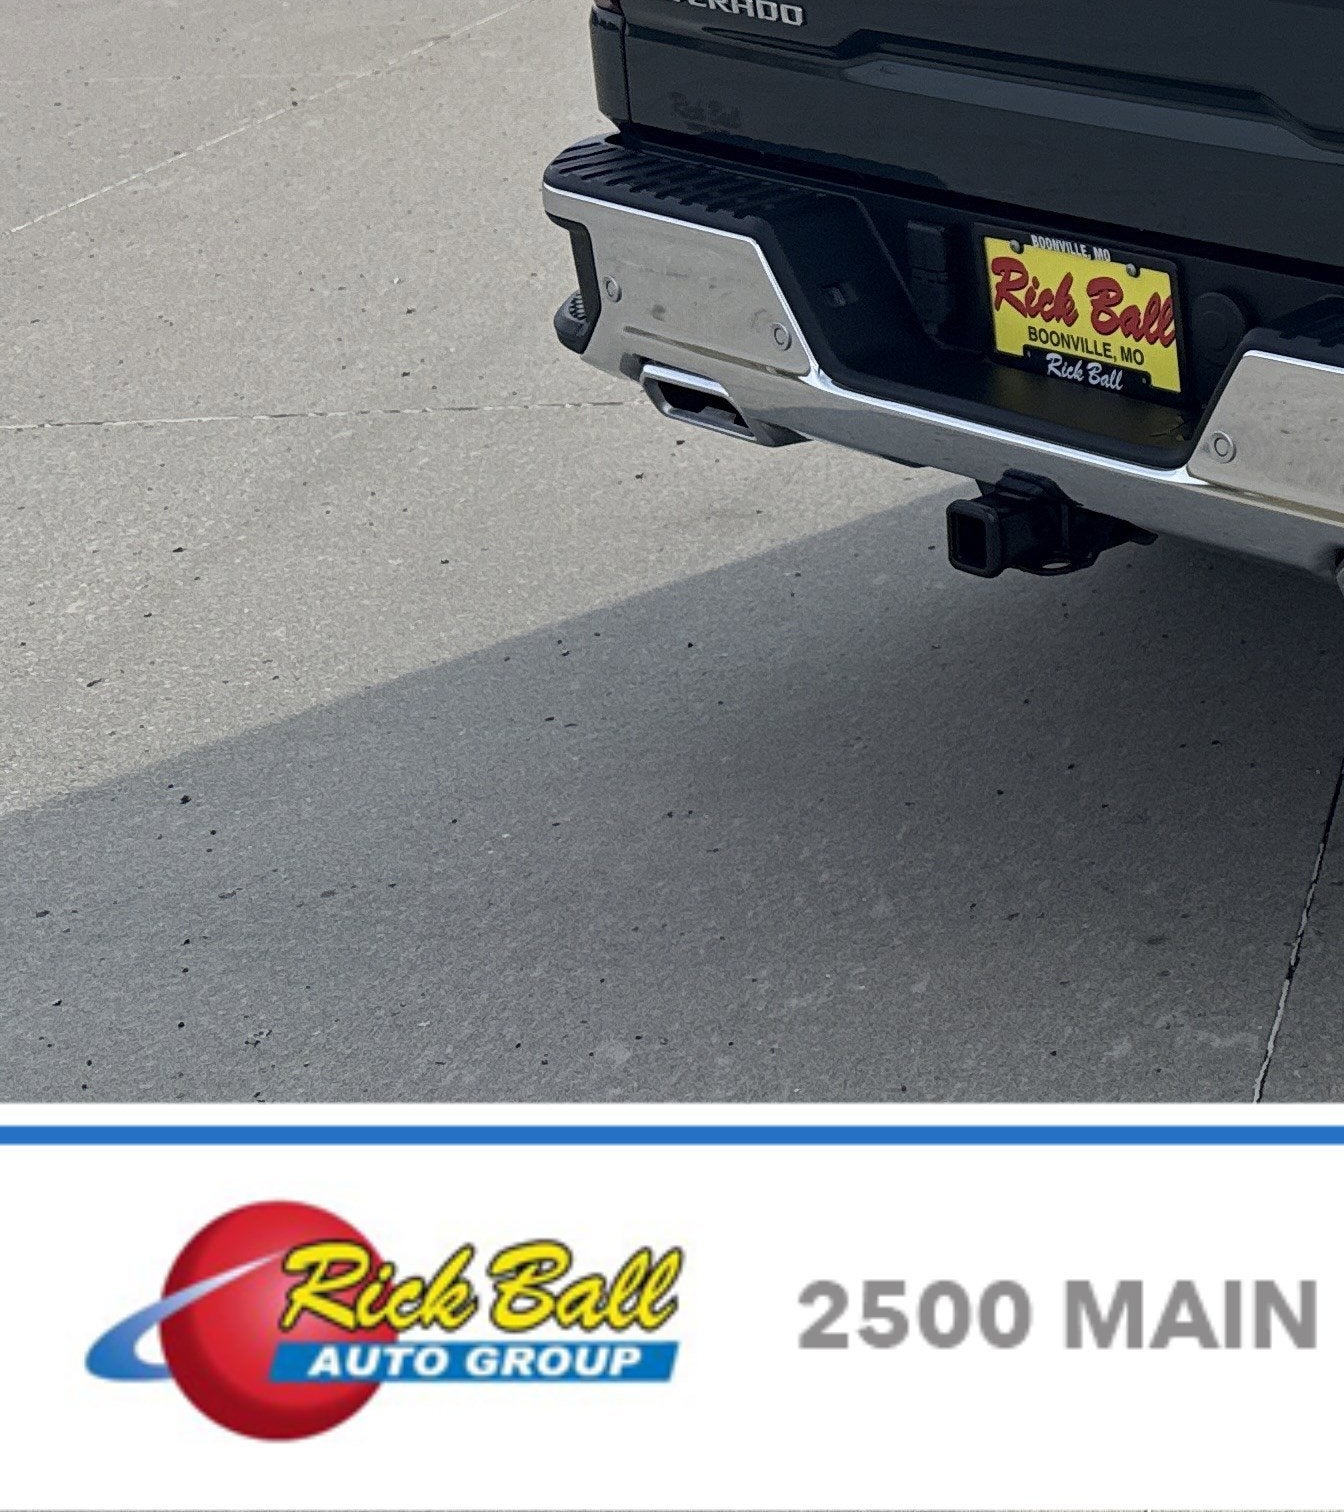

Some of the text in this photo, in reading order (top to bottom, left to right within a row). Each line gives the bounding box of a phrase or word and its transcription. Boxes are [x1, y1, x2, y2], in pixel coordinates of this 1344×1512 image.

[1030, 234, 1112, 262] BOONVILLE, MO
[991, 256, 1177, 348] Rick Ball
[1027, 326, 1145, 366] BOONVILLE, MO
[1045, 353, 1124, 391] Rick Ball
